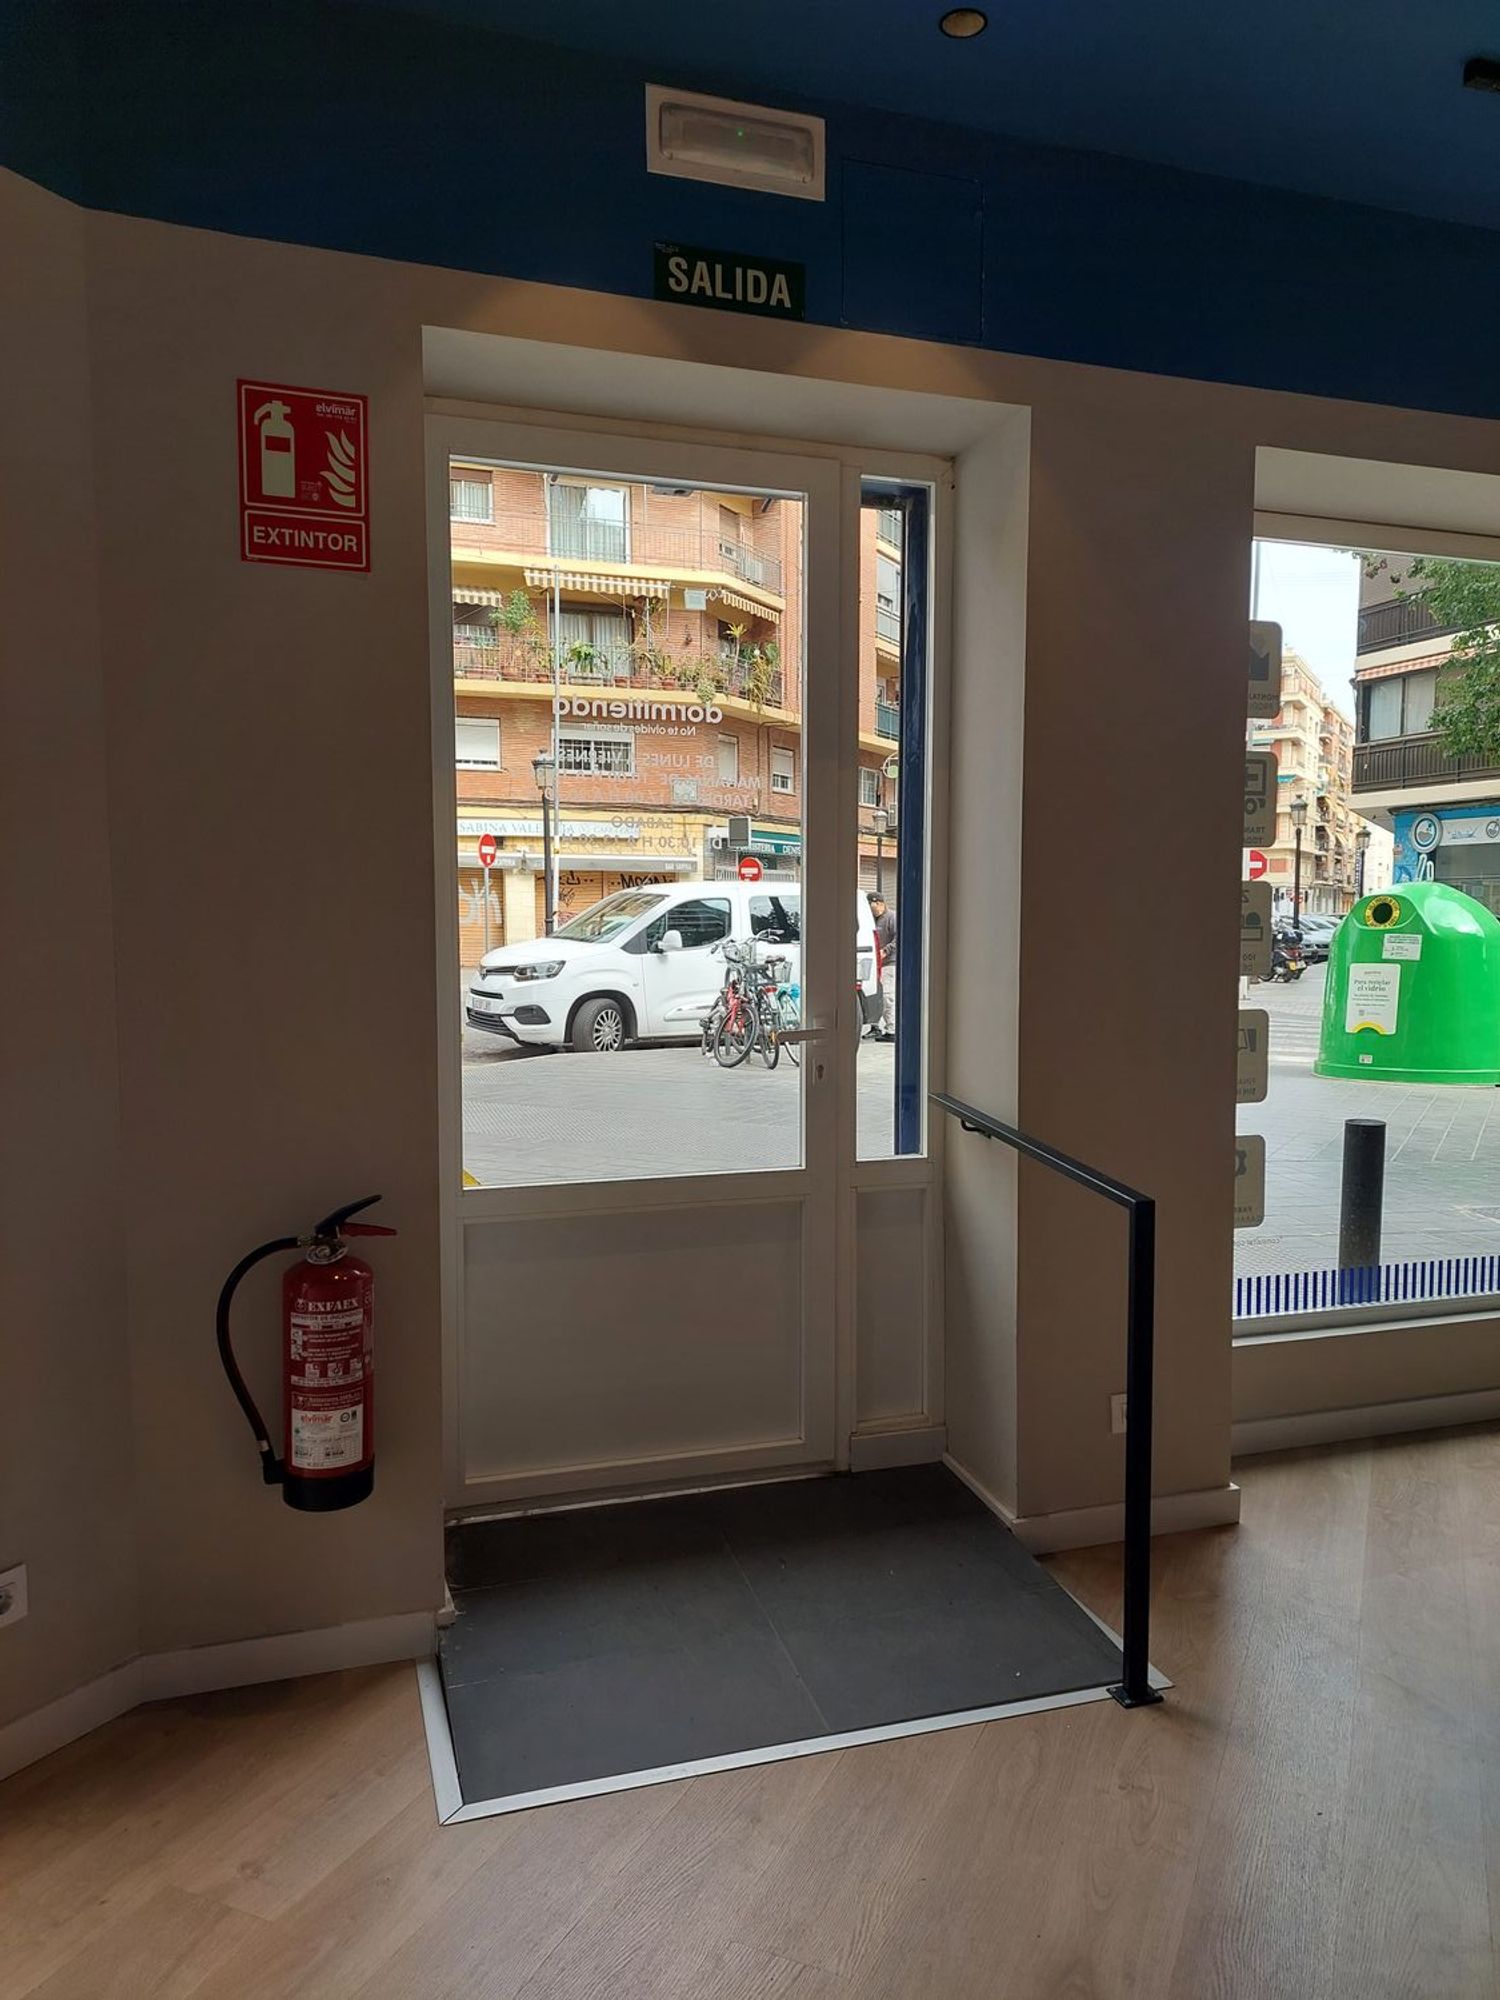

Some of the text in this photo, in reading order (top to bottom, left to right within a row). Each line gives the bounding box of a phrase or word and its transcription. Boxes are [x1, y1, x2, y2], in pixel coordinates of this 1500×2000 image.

[668, 256, 792, 308] SALIDA
[315, 403, 356, 417] elvimar
[253, 526, 358, 552] EXTINTOR
